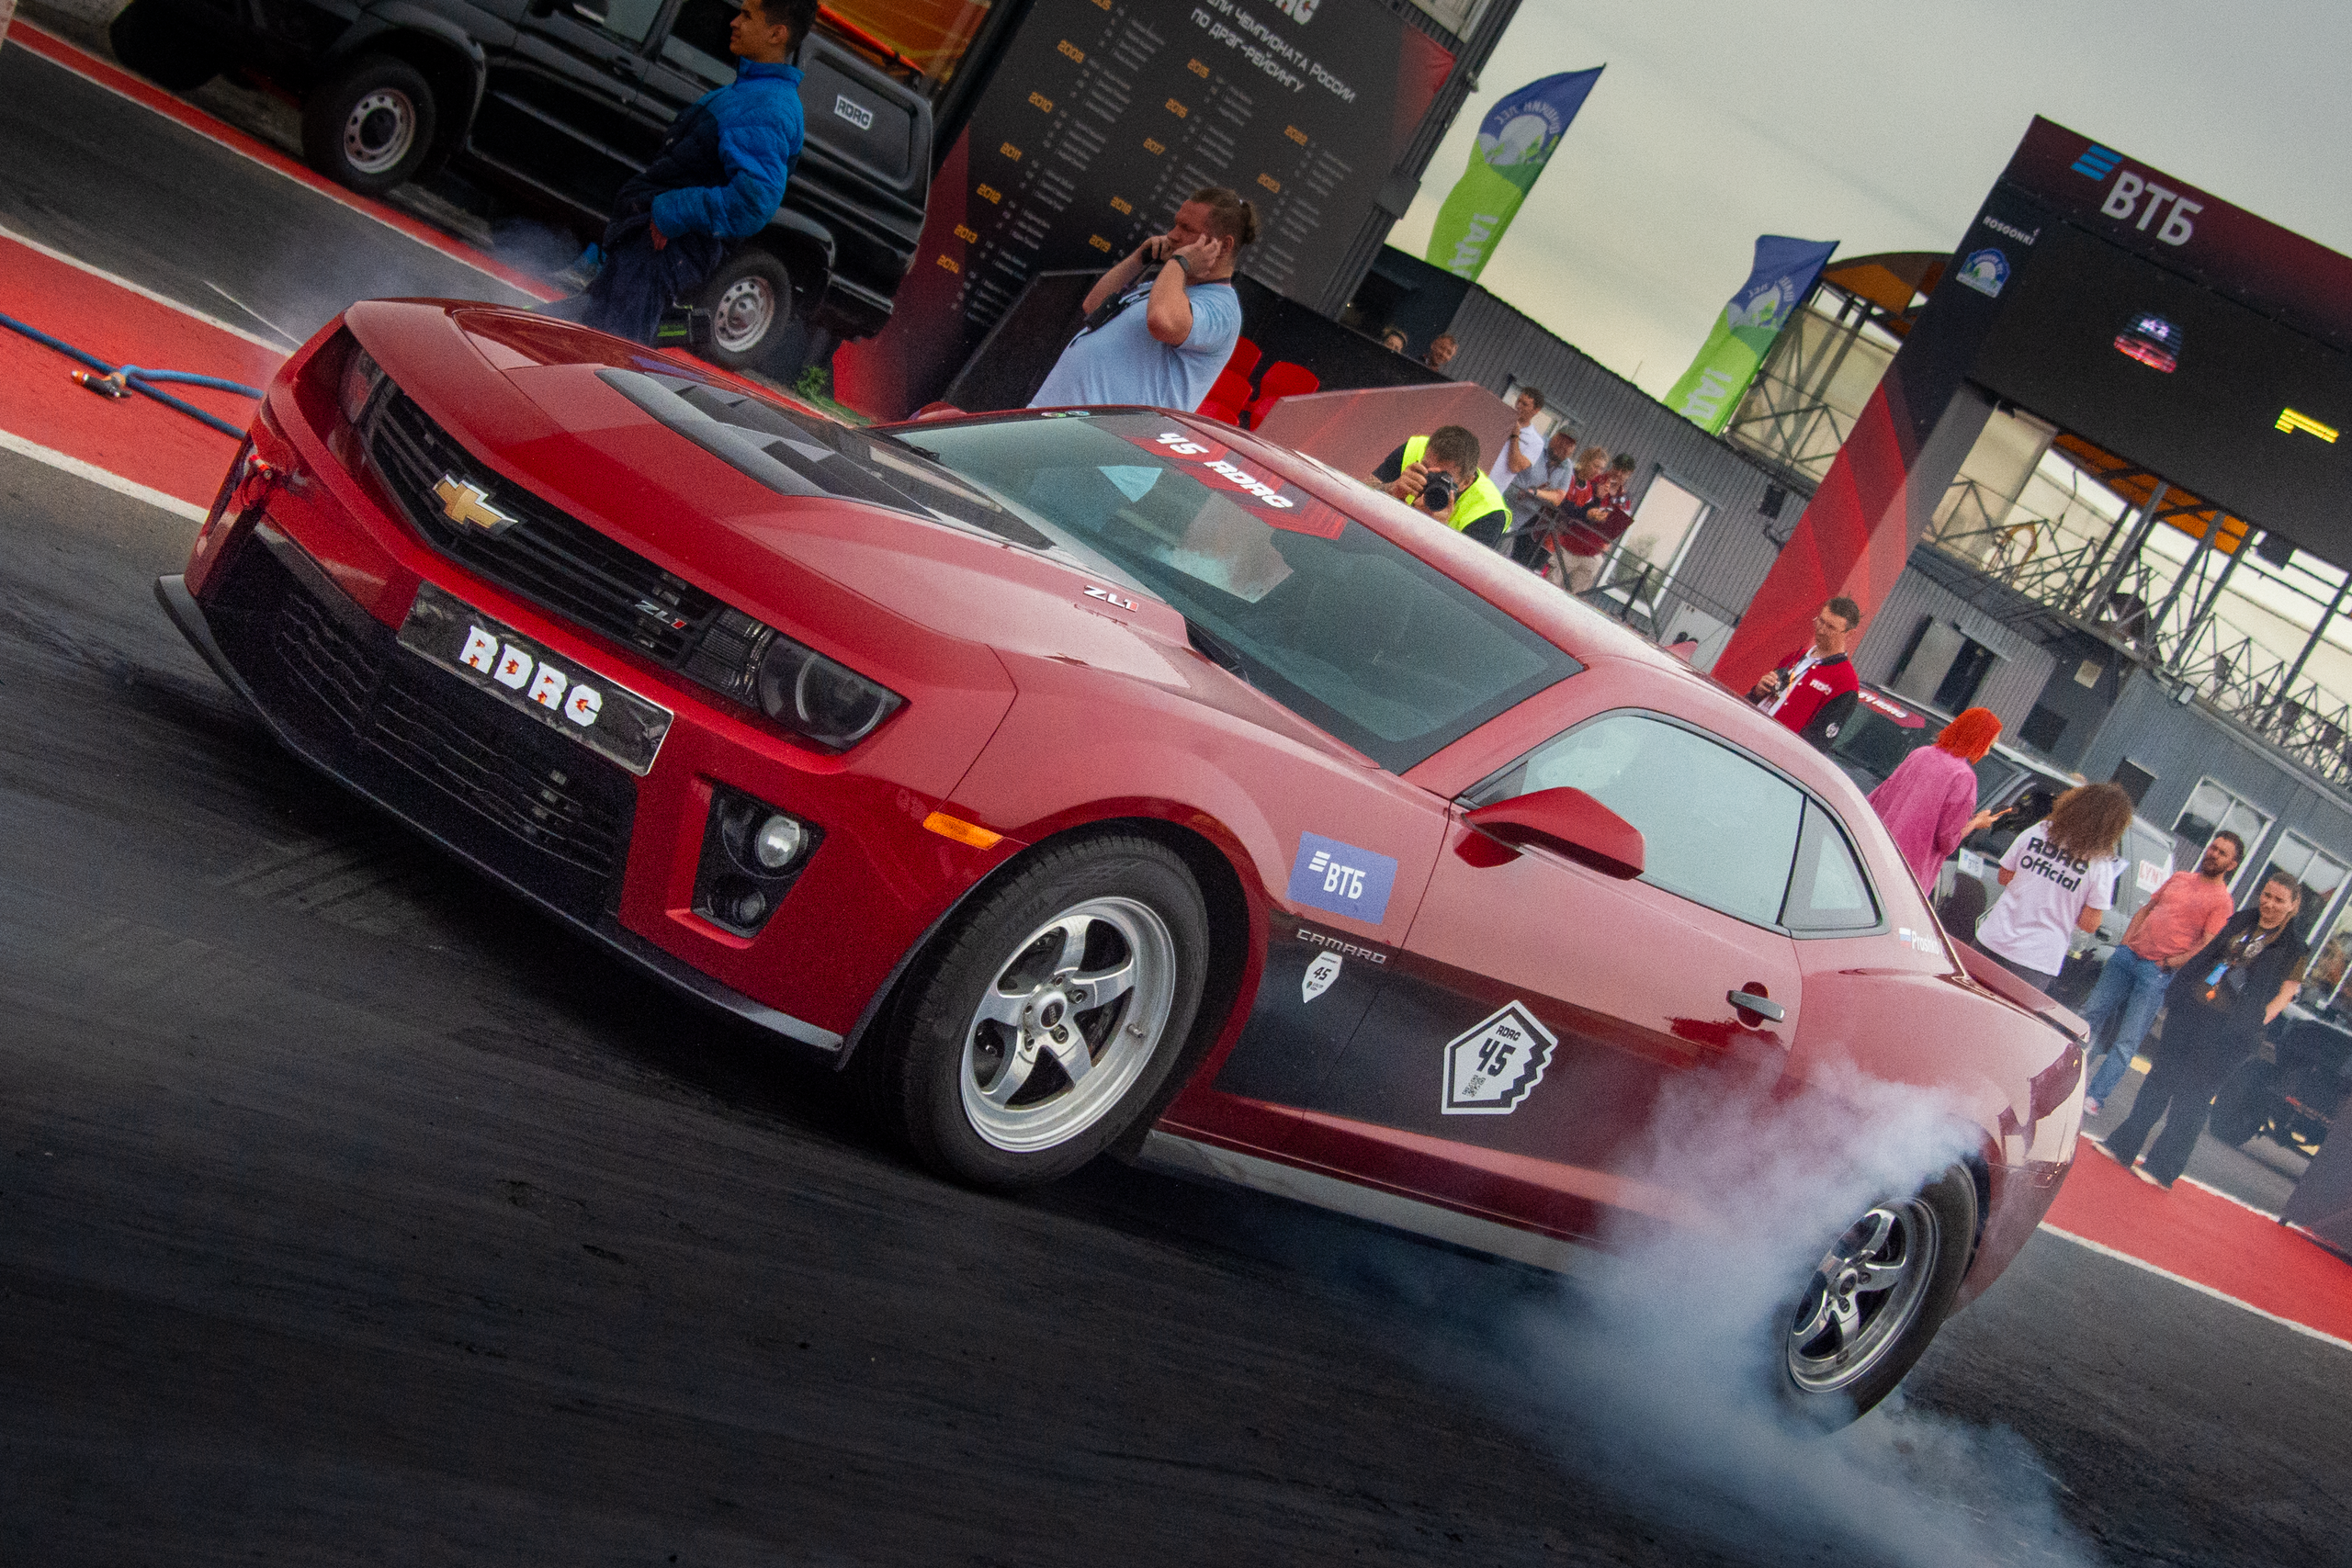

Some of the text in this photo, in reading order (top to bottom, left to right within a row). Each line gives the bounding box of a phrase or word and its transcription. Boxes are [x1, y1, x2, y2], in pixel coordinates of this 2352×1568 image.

[1191, 7, 1211, 28] ПО
[1208, 22, 1305, 93] ДРЭГ-РЕЙСИНГУ
[837, 99, 871, 127] RDRC
[1028, 91, 1053, 113] 2010
[1000, 141, 1023, 162] 2011
[1143, 137, 1166, 156] 2017
[976, 183, 1001, 204] 2012
[2100, 170, 2204, 246] ВТБ
[954, 224, 978, 243] 2013
[936, 254, 960, 274] 2014
[1156, 433, 1293, 508] 45 RDRC
[1082, 584, 1138, 613] ZL1
[635, 600, 687, 629] ZL1
[459, 626, 603, 727] RDRC
[1323, 863, 1366, 899] ВТБ
[2020, 855, 2082, 892] Official
[1296, 929, 1387, 964] CAMARO
[1313, 966, 1332, 982] 45
[1496, 1024, 1521, 1041] RDRC
[1476, 1038, 1516, 1077] 45
